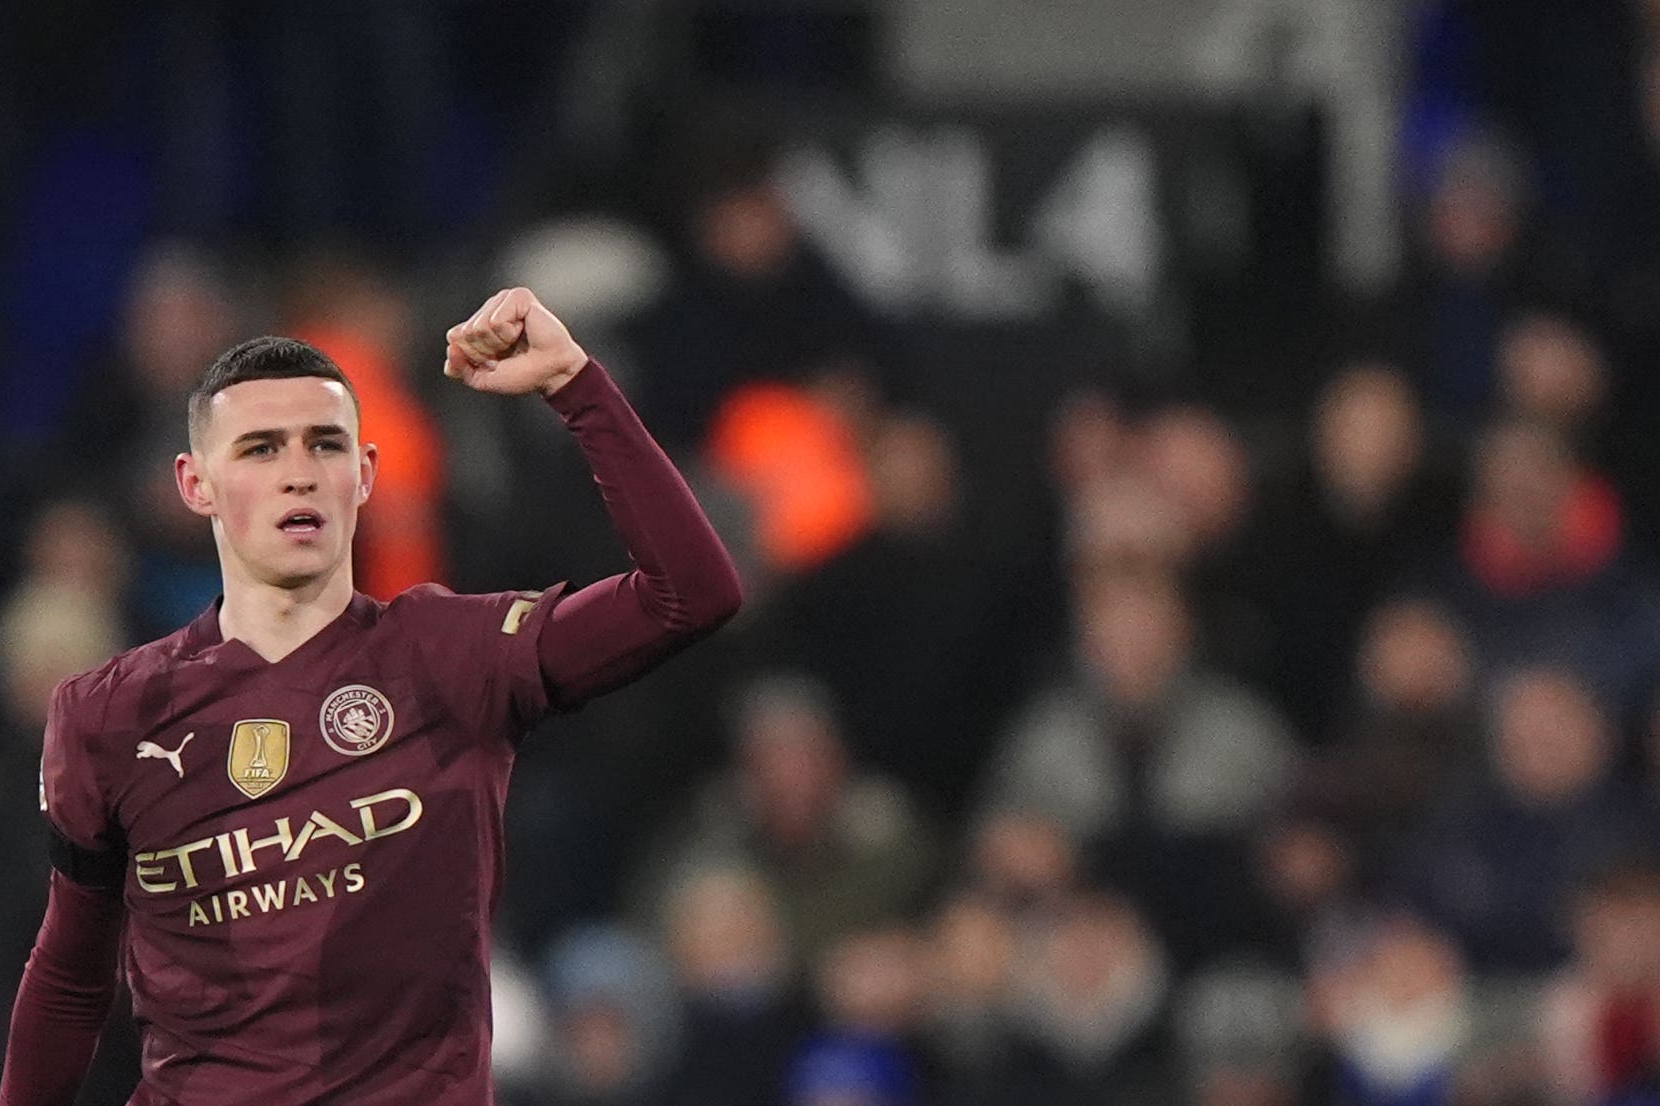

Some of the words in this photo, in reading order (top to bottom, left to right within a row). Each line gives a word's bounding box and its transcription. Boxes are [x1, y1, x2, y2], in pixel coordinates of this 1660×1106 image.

[326, 691, 379, 722] MANCHESTER
[357, 737, 378, 751] CITY
[244, 768, 271, 778] FIFA
[135, 787, 424, 893] ETIHAD
[188, 862, 366, 928] AIRWAYS
